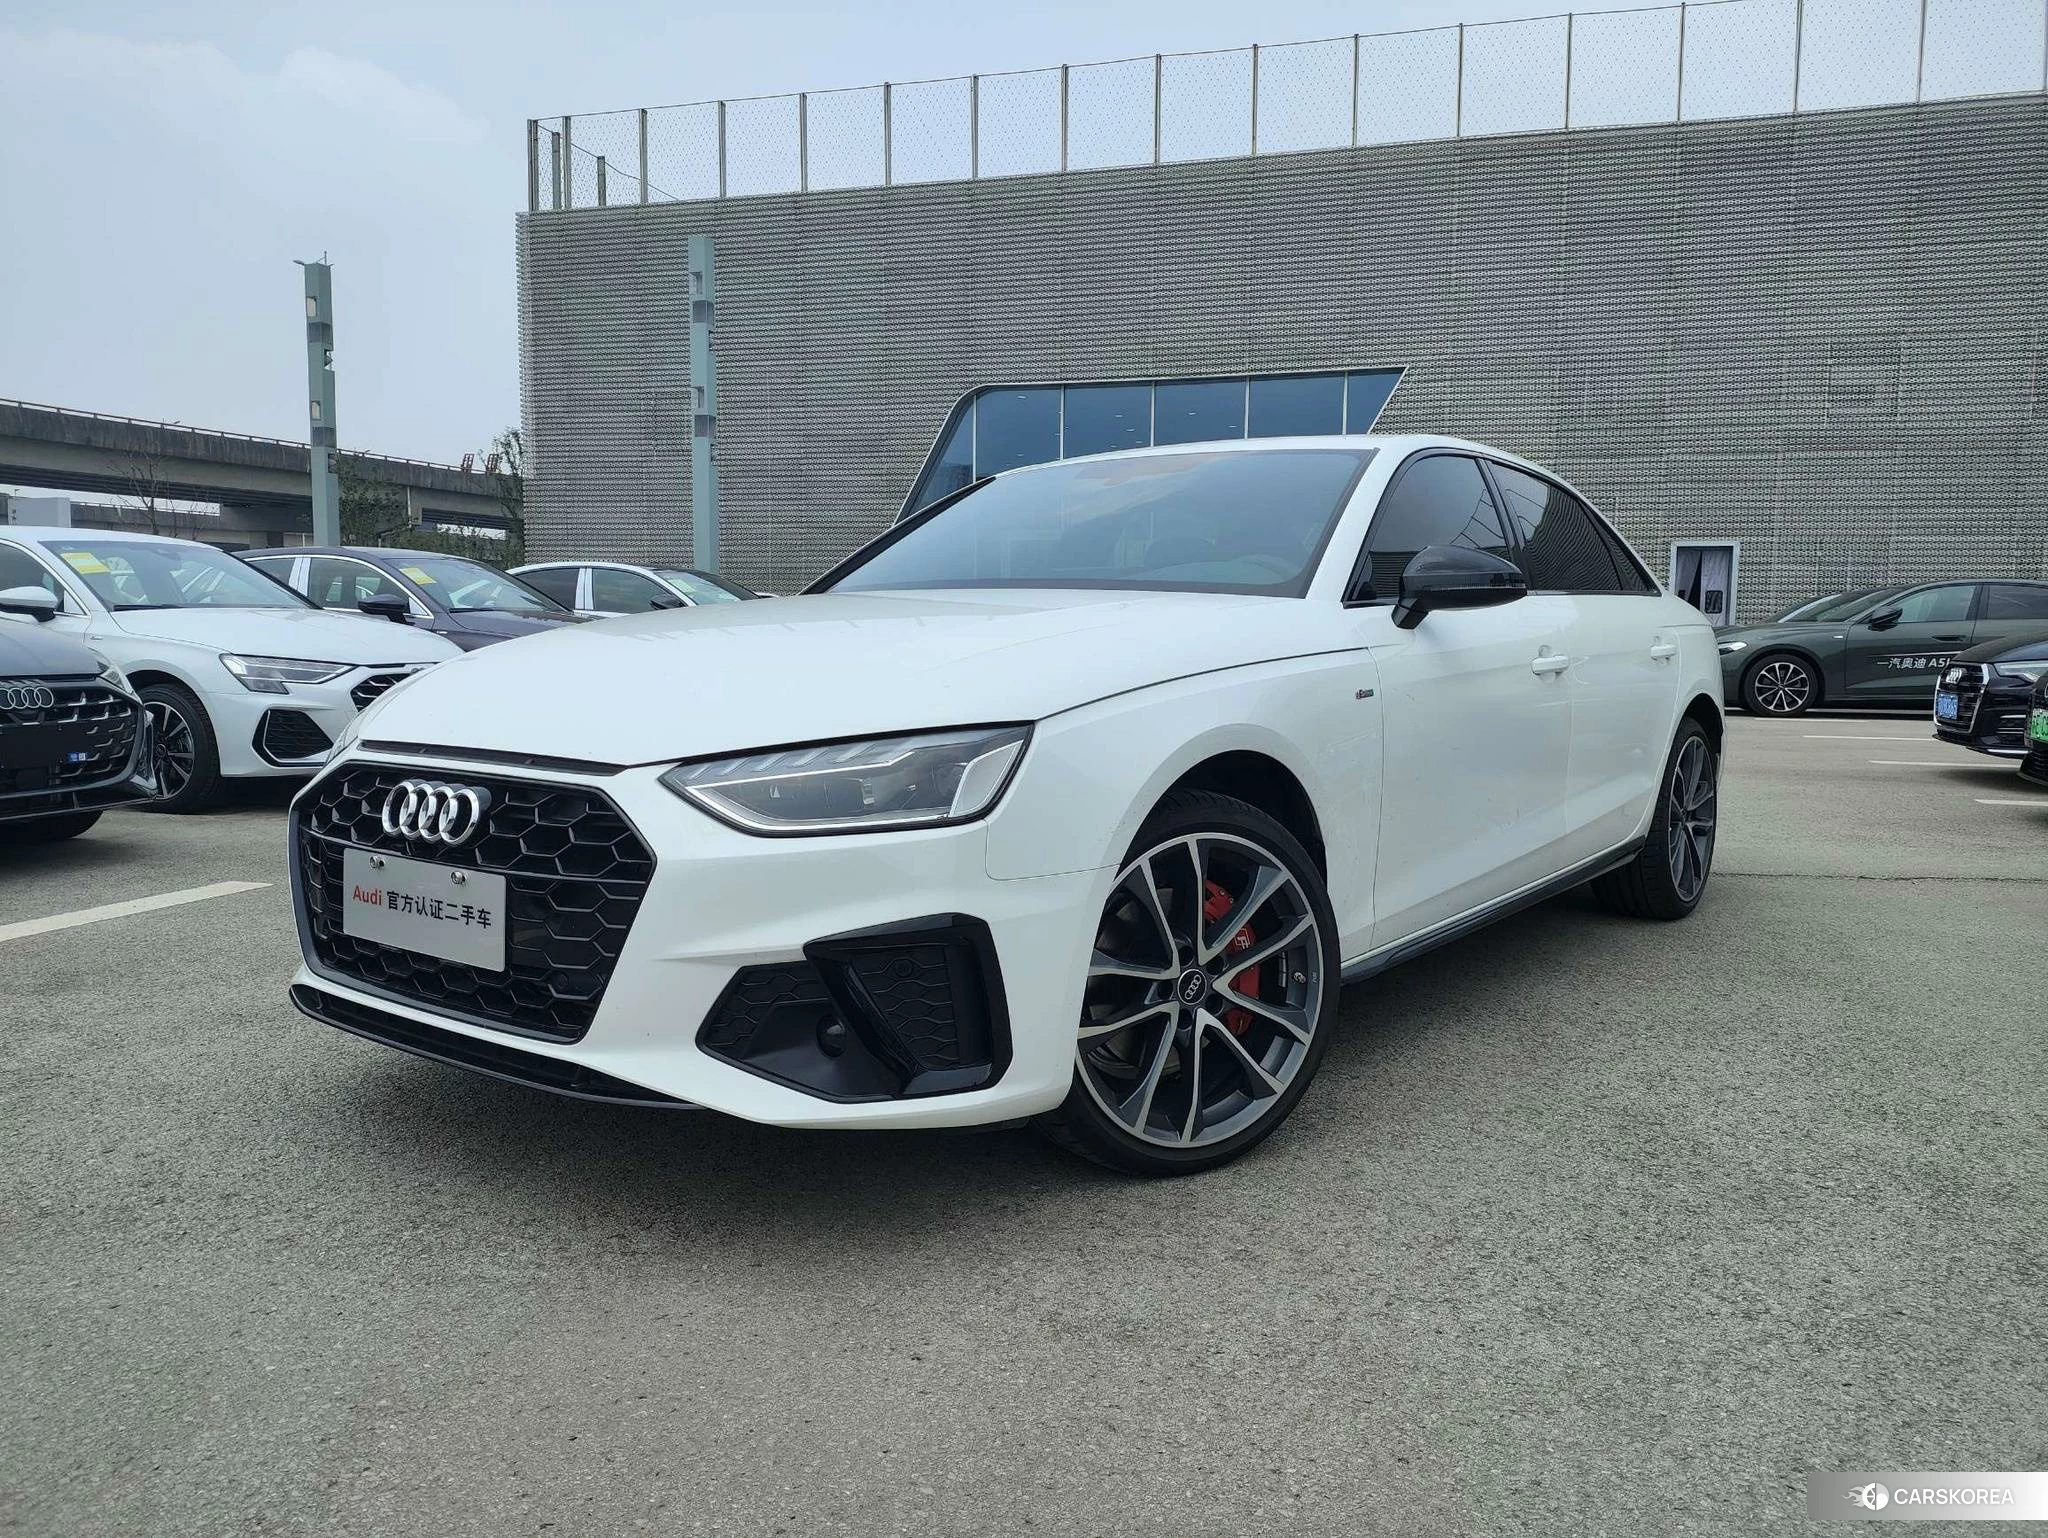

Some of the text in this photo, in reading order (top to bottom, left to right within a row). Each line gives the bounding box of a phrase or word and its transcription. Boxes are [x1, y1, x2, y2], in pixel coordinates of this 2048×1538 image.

[1877, 657, 1927, 669] 一汽奥迪
[352, 885, 492, 929] Audi 官方认证二手车
